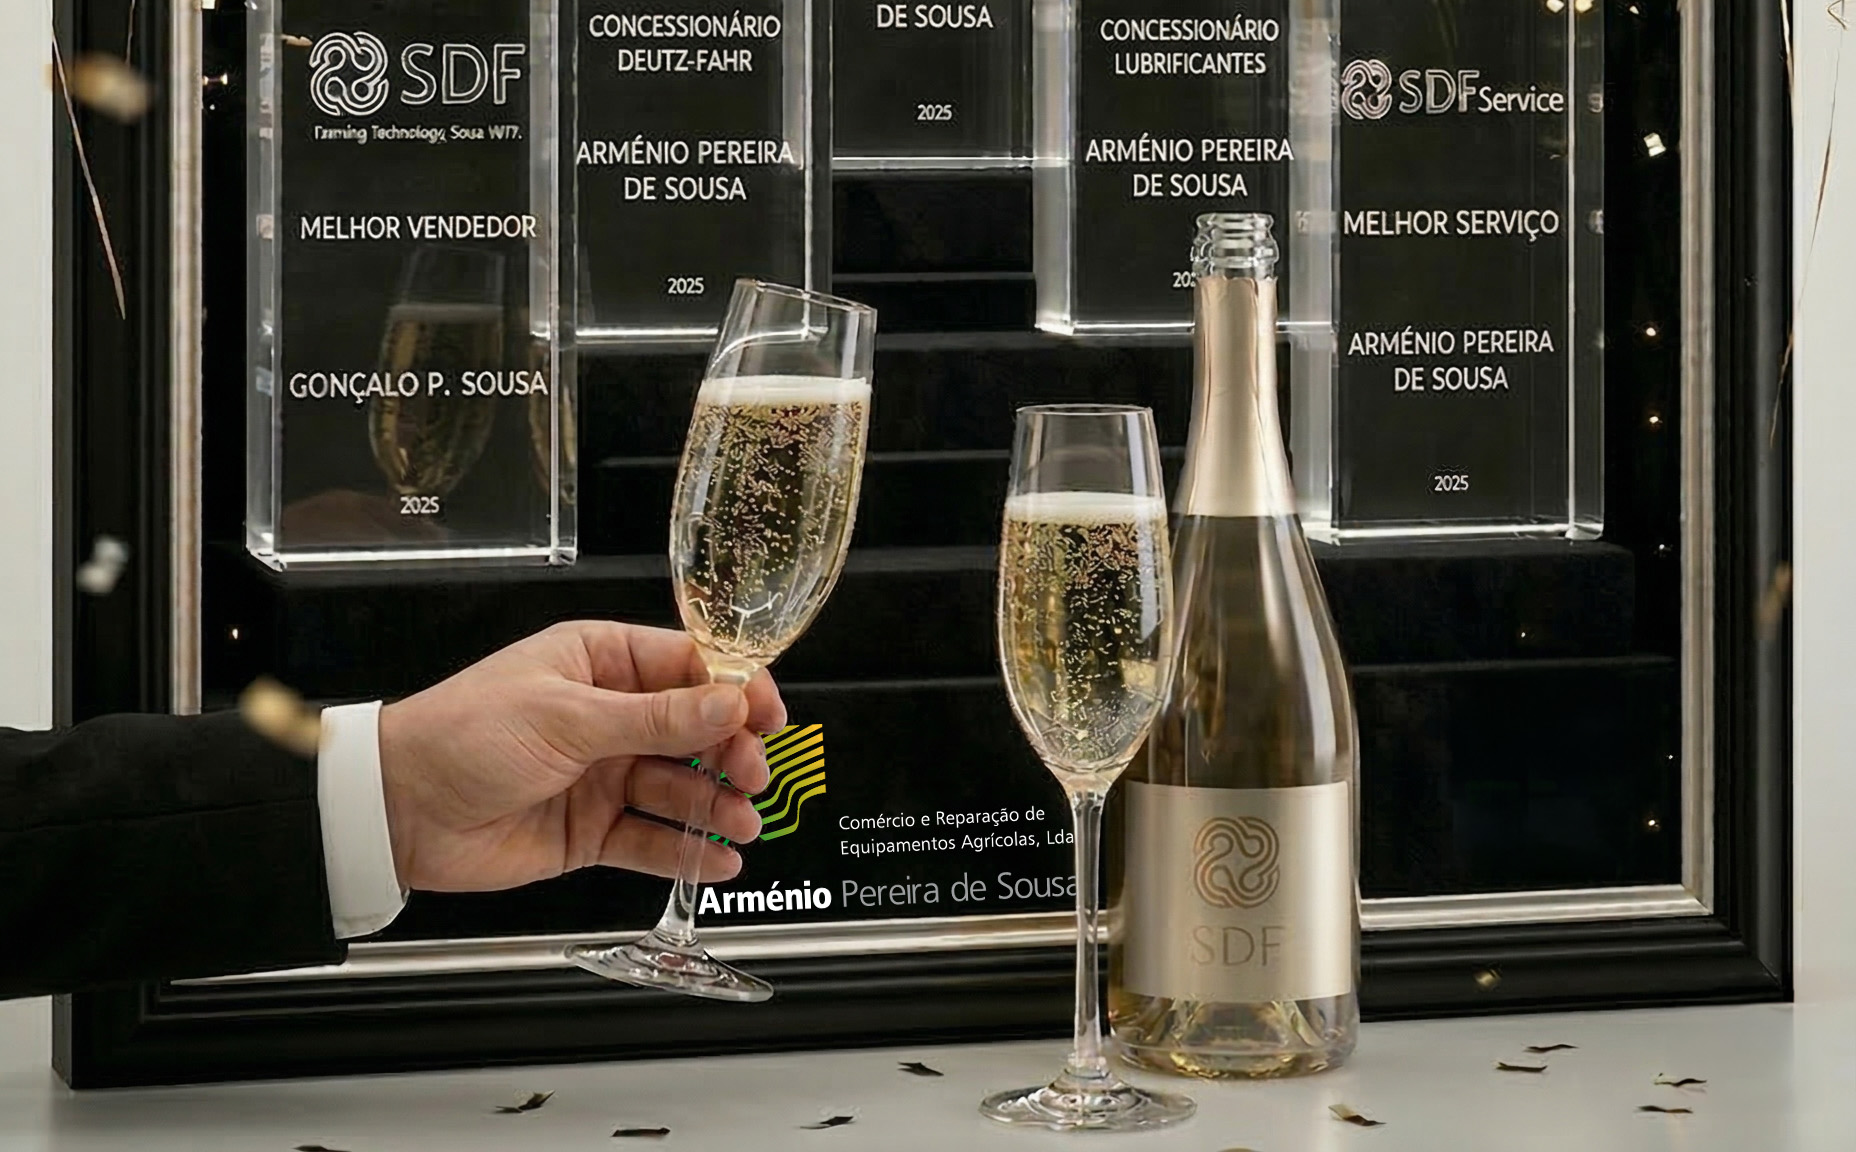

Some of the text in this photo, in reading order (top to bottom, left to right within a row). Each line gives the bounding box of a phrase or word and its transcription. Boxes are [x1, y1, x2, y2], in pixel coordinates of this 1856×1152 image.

[589, 9, 782, 38] CONCESSIONÁRIO
[876, 3, 994, 29] DE SOUSA
[1100, 13, 1280, 42] CONCESSIONÁRIO
[400, 42, 526, 105] SDF
[618, 48, 753, 72] DEUTZ-FAHR
[1115, 52, 1267, 75] LUBRIFICANTES
[917, 104, 953, 121] 2025
[574, 132, 797, 168] ARMÉNIO PEREIRA
[1085, 132, 1296, 163] ARMÉNIO PEREIRA
[624, 176, 747, 201] DE SOUSA
[1133, 173, 1248, 197] DE SOUSA
[300, 212, 539, 240] MELHOR VENDEDOR
[1344, 210, 1449, 236] MELHOR
[1456, 209, 1559, 242] SERVIÇO
[667, 277, 705, 294] 2025
[1347, 325, 1555, 356] ARMÉNIO PEREIRA
[289, 370, 549, 404] GONÇALO P. SOUSA
[1394, 365, 1509, 391] DE SOUSA
[1434, 474, 1469, 492] 2025
[400, 496, 440, 515] 2025
[838, 805, 1045, 830] Comércio e Reparação de
[840, 837, 956, 858] Equipamentos
[961, 831, 1040, 853] Agrícolas,
[697, 881, 832, 915] Arménio
[842, 875, 939, 908] Pereira
[951, 872, 987, 902] de
[1192, 925, 1286, 967] SDF
